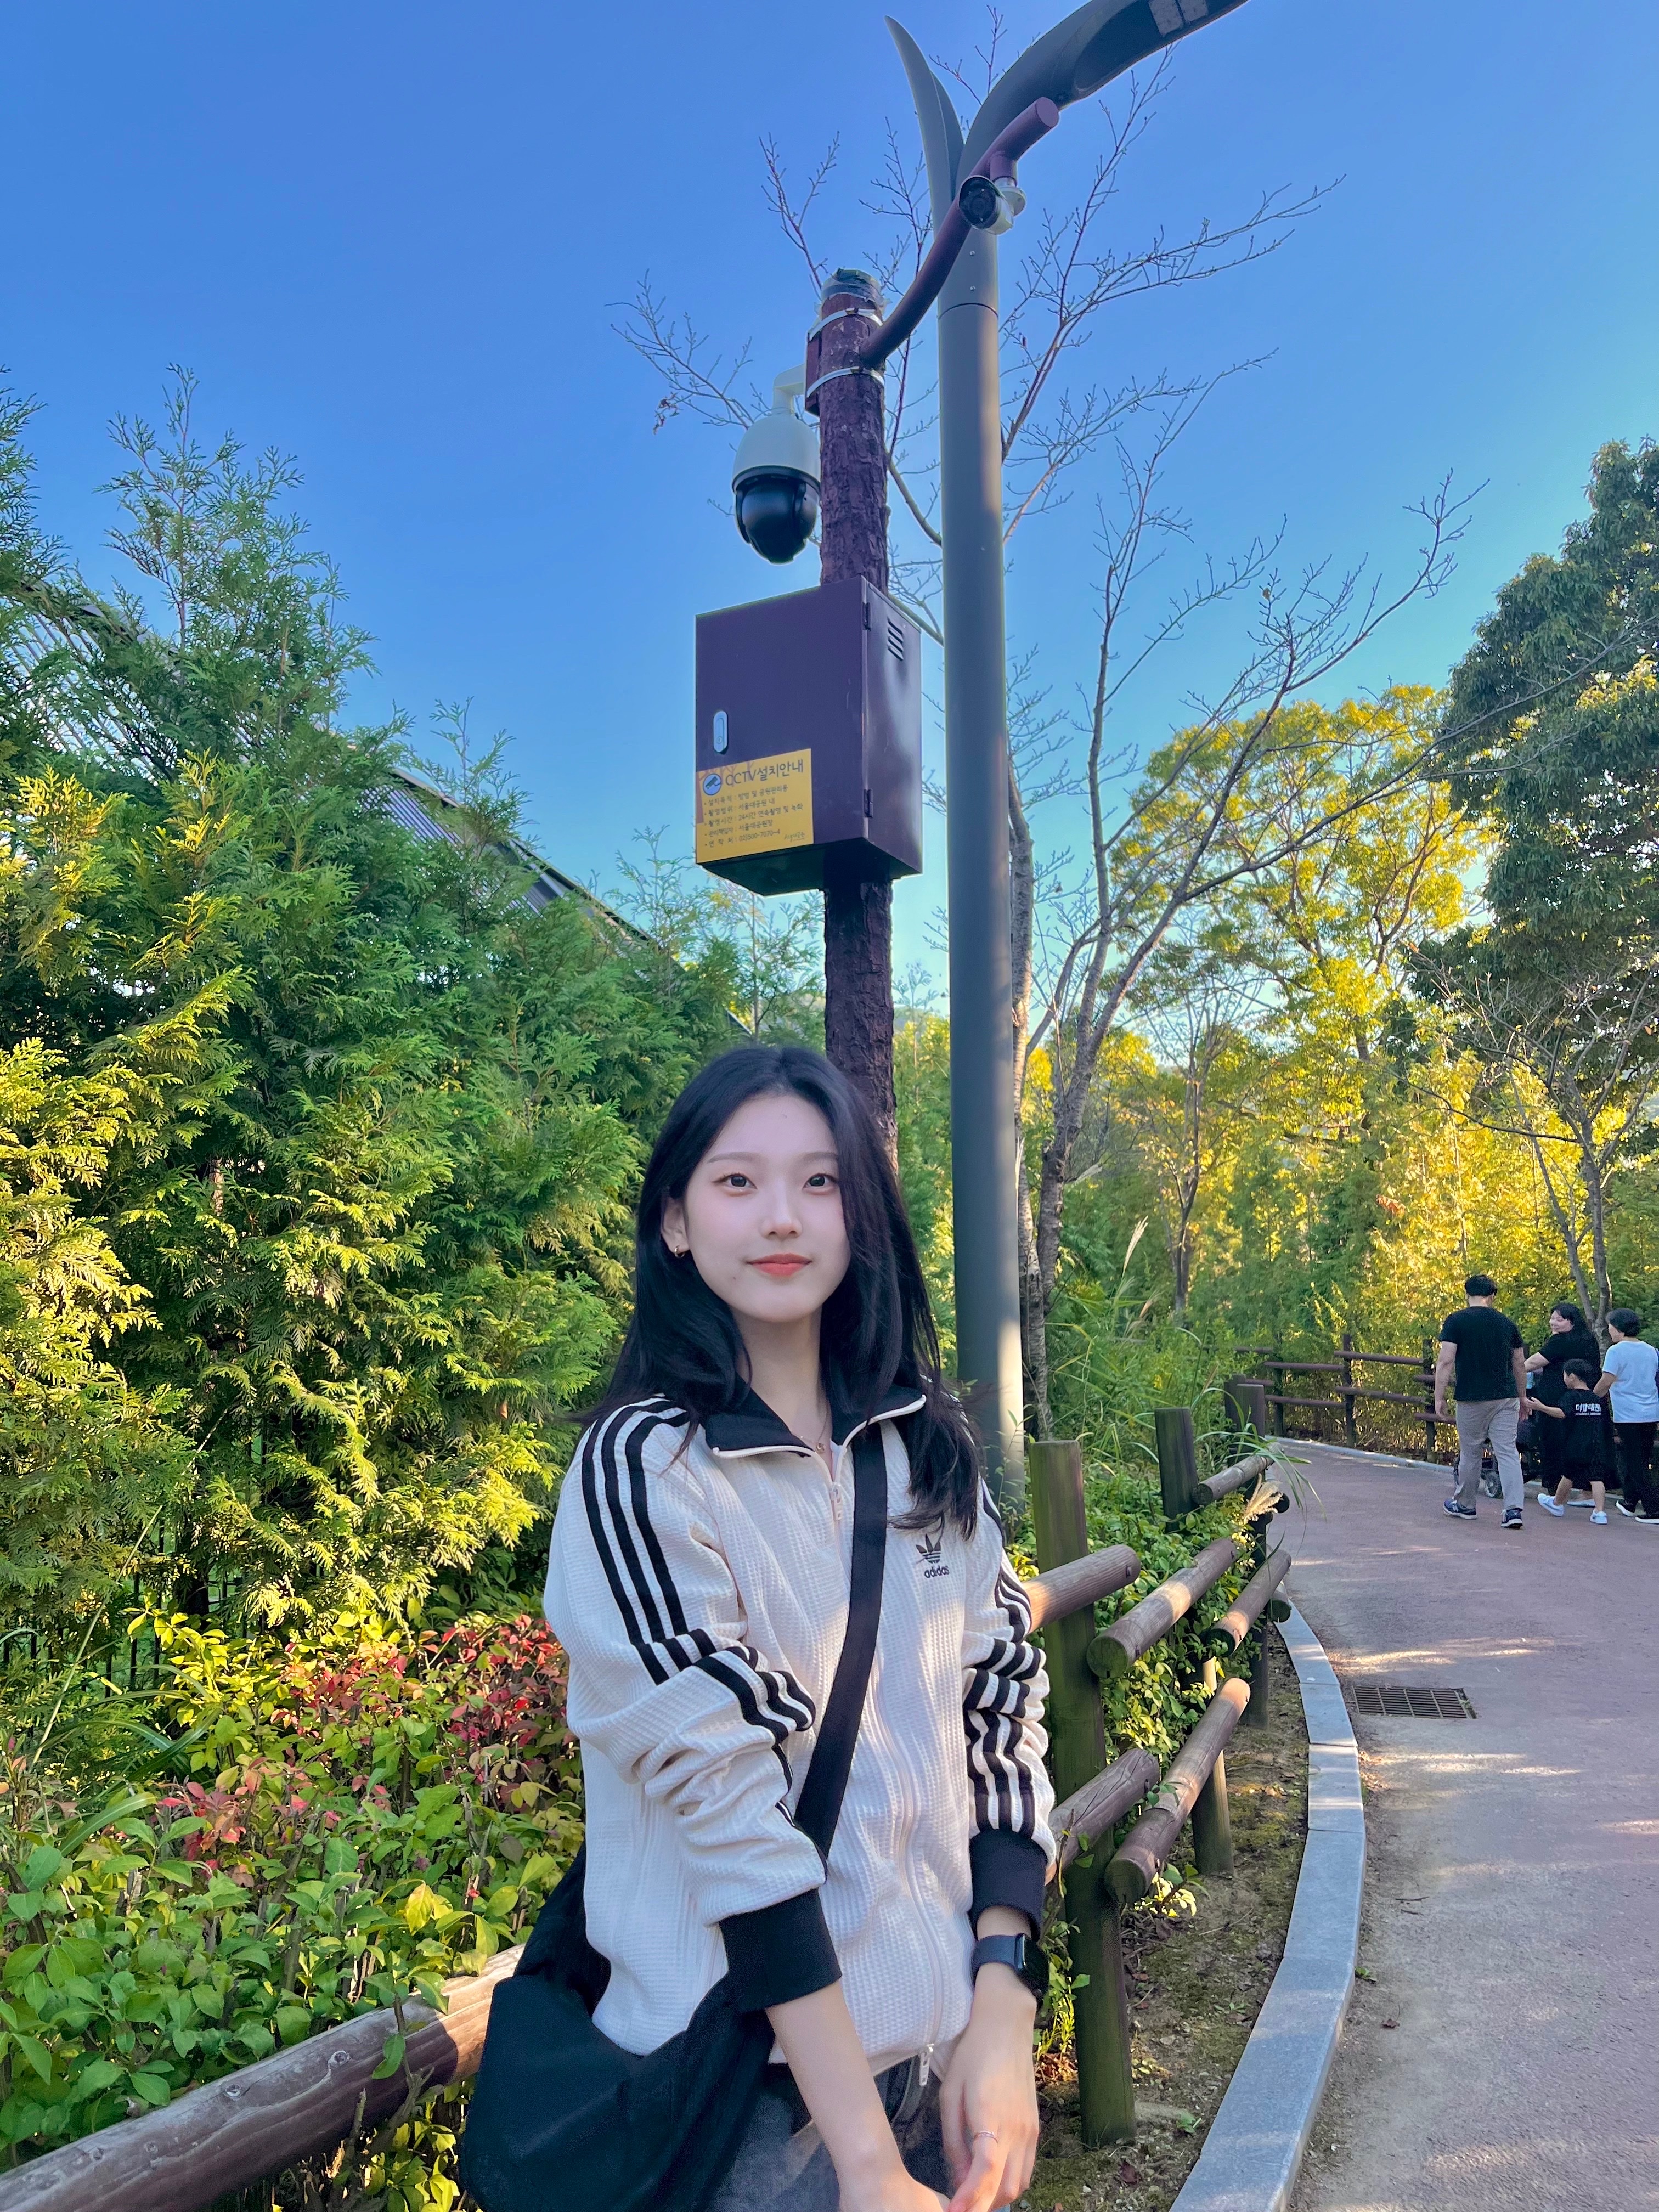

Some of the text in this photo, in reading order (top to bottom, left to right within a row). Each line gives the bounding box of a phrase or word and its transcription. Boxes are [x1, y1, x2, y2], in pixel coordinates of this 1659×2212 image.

[738, 799, 767, 810] 서울대공원
[738, 812, 756, 821] 24시간
[924, 1565, 950, 1578] adidas
